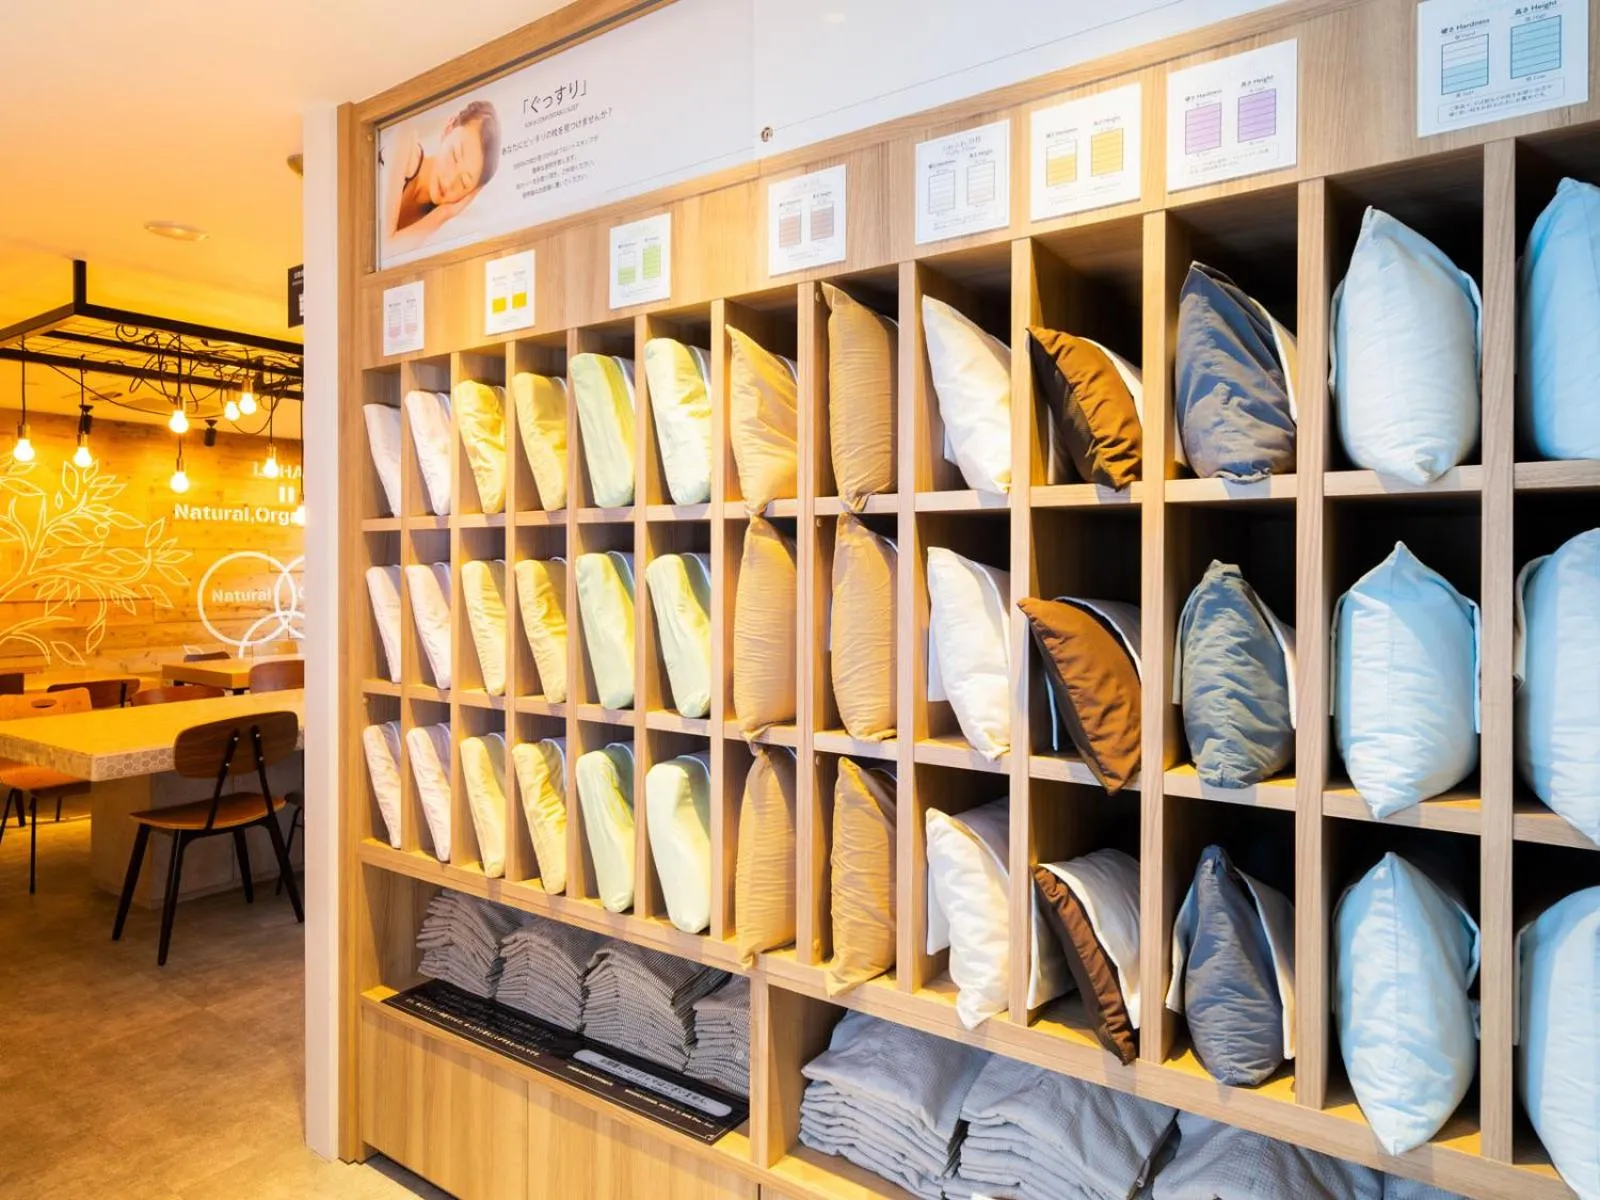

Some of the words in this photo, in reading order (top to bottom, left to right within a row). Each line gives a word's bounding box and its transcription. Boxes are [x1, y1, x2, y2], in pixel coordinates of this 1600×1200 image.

[523, 79, 587, 114] 「ぐっすり」
[252, 461, 304, 480] LHA
[211, 586, 272, 604] Natural
